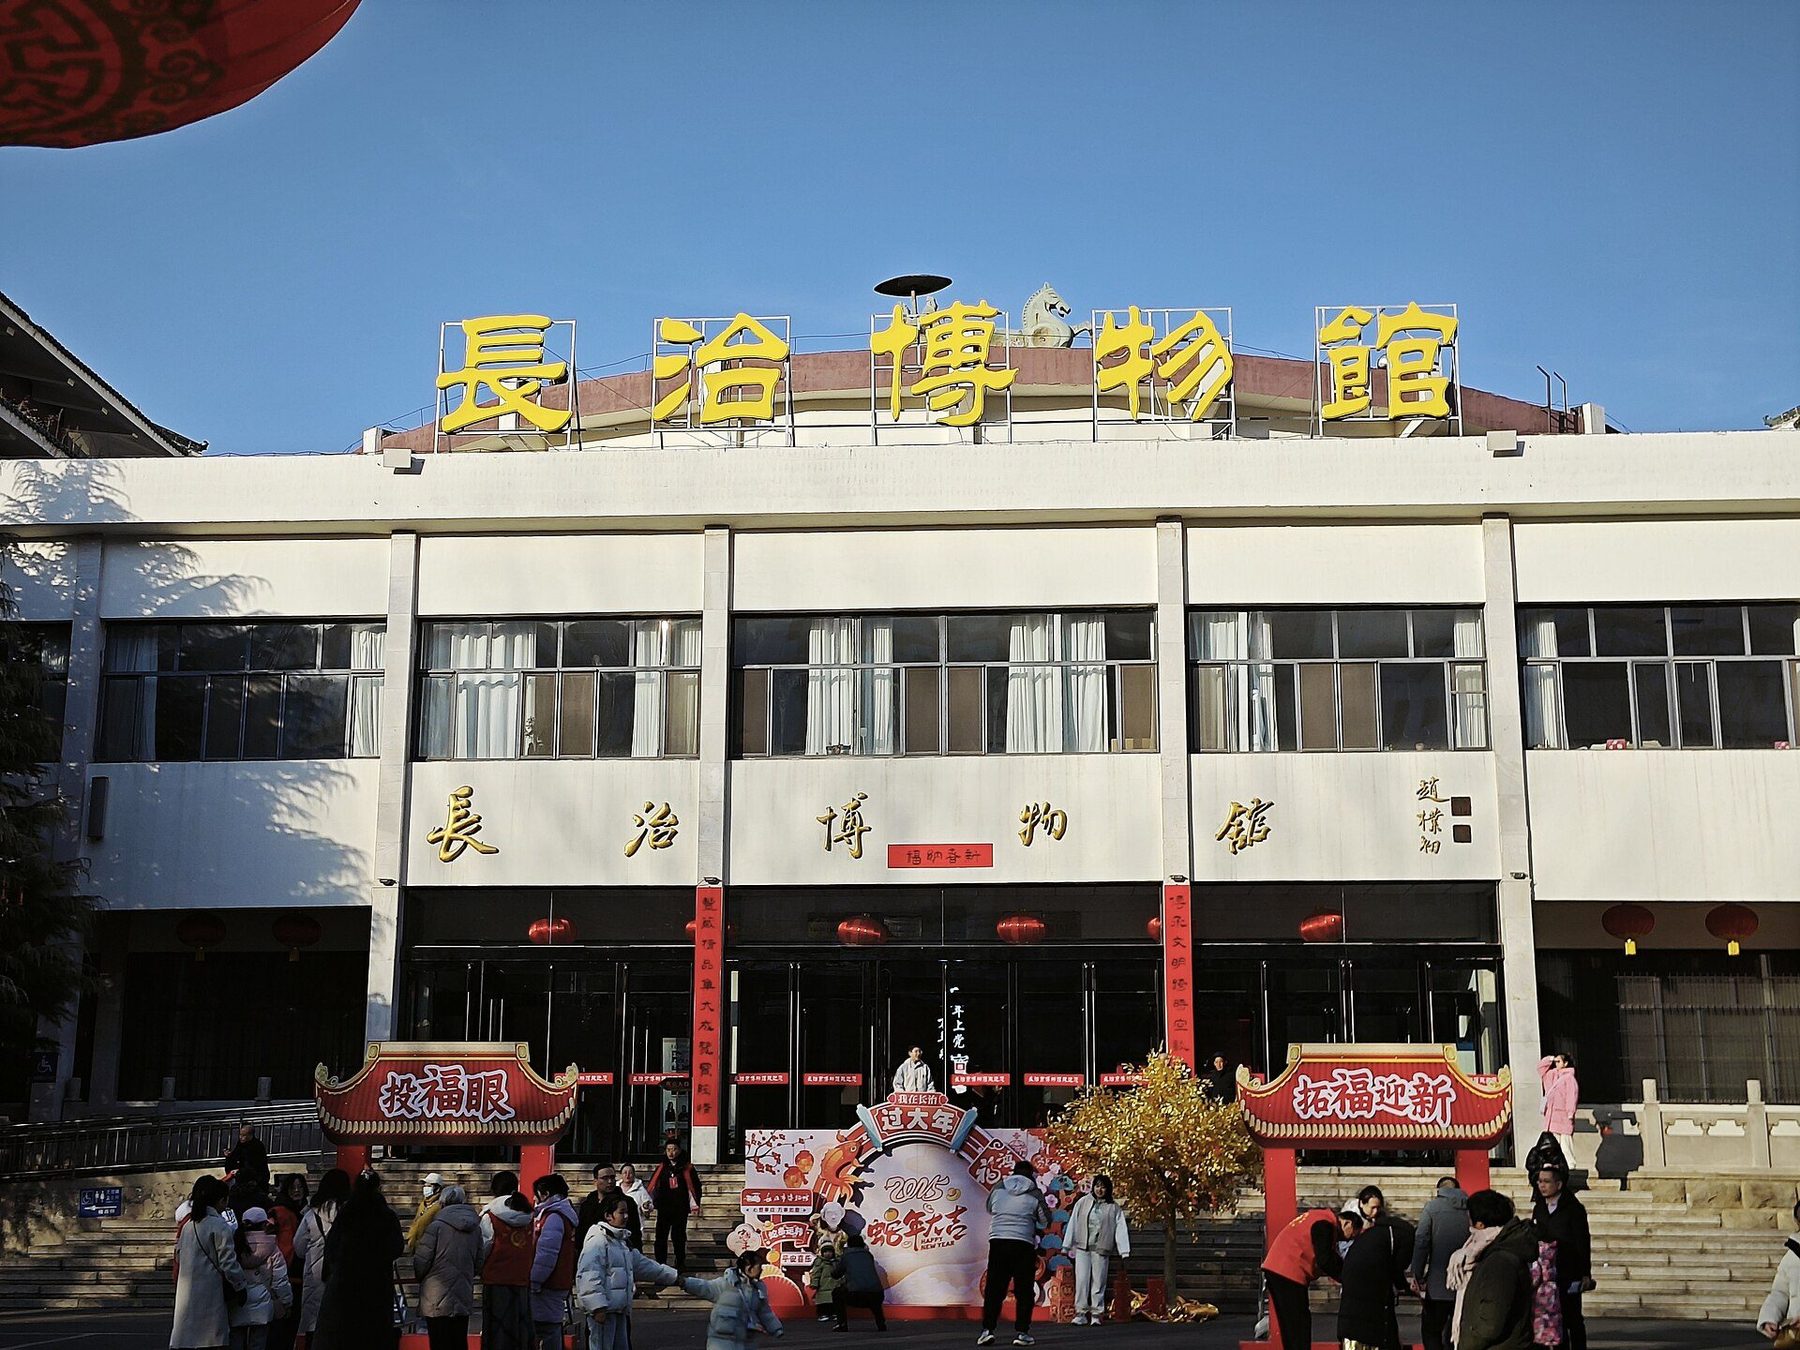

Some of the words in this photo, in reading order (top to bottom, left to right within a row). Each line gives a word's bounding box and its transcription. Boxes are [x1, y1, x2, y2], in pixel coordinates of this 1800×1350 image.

[436, 300, 1458, 433] 長治博物館
[380, 1064, 515, 1122] 投福眼
[1293, 1068, 1456, 1127] 拓福迎新
[881, 1107, 955, 1133] 过大年
[884, 1174, 951, 1203] 2025
[867, 1205, 968, 1251] 蛇年大吉
[920, 1236, 943, 1244] HAPPY
[920, 1243, 936, 1251] NEW
[937, 1240, 955, 1248] YEAR
